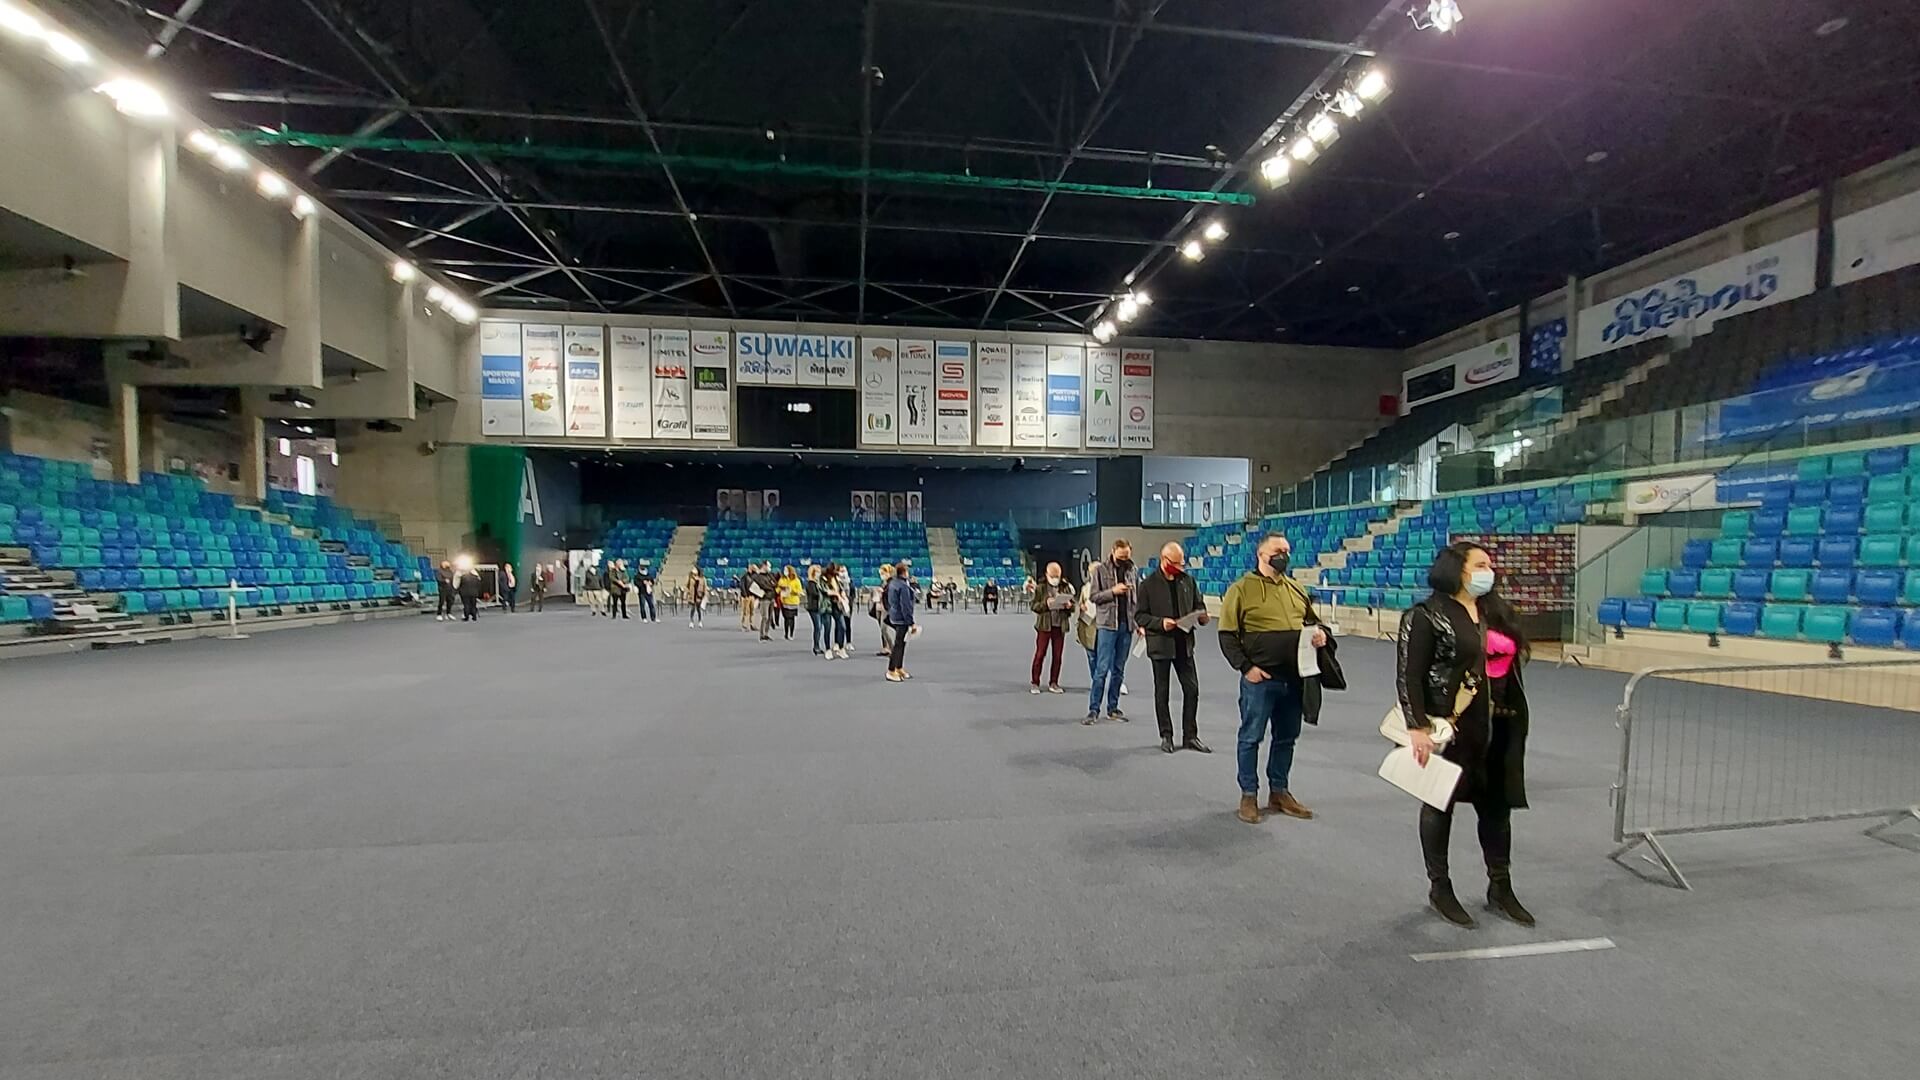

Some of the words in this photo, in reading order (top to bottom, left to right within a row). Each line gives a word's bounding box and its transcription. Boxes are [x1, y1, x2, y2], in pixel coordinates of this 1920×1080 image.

[740, 336, 852, 358] SUWAŁKI
[661, 420, 688, 430] Grafit
[517, 456, 543, 526] A
